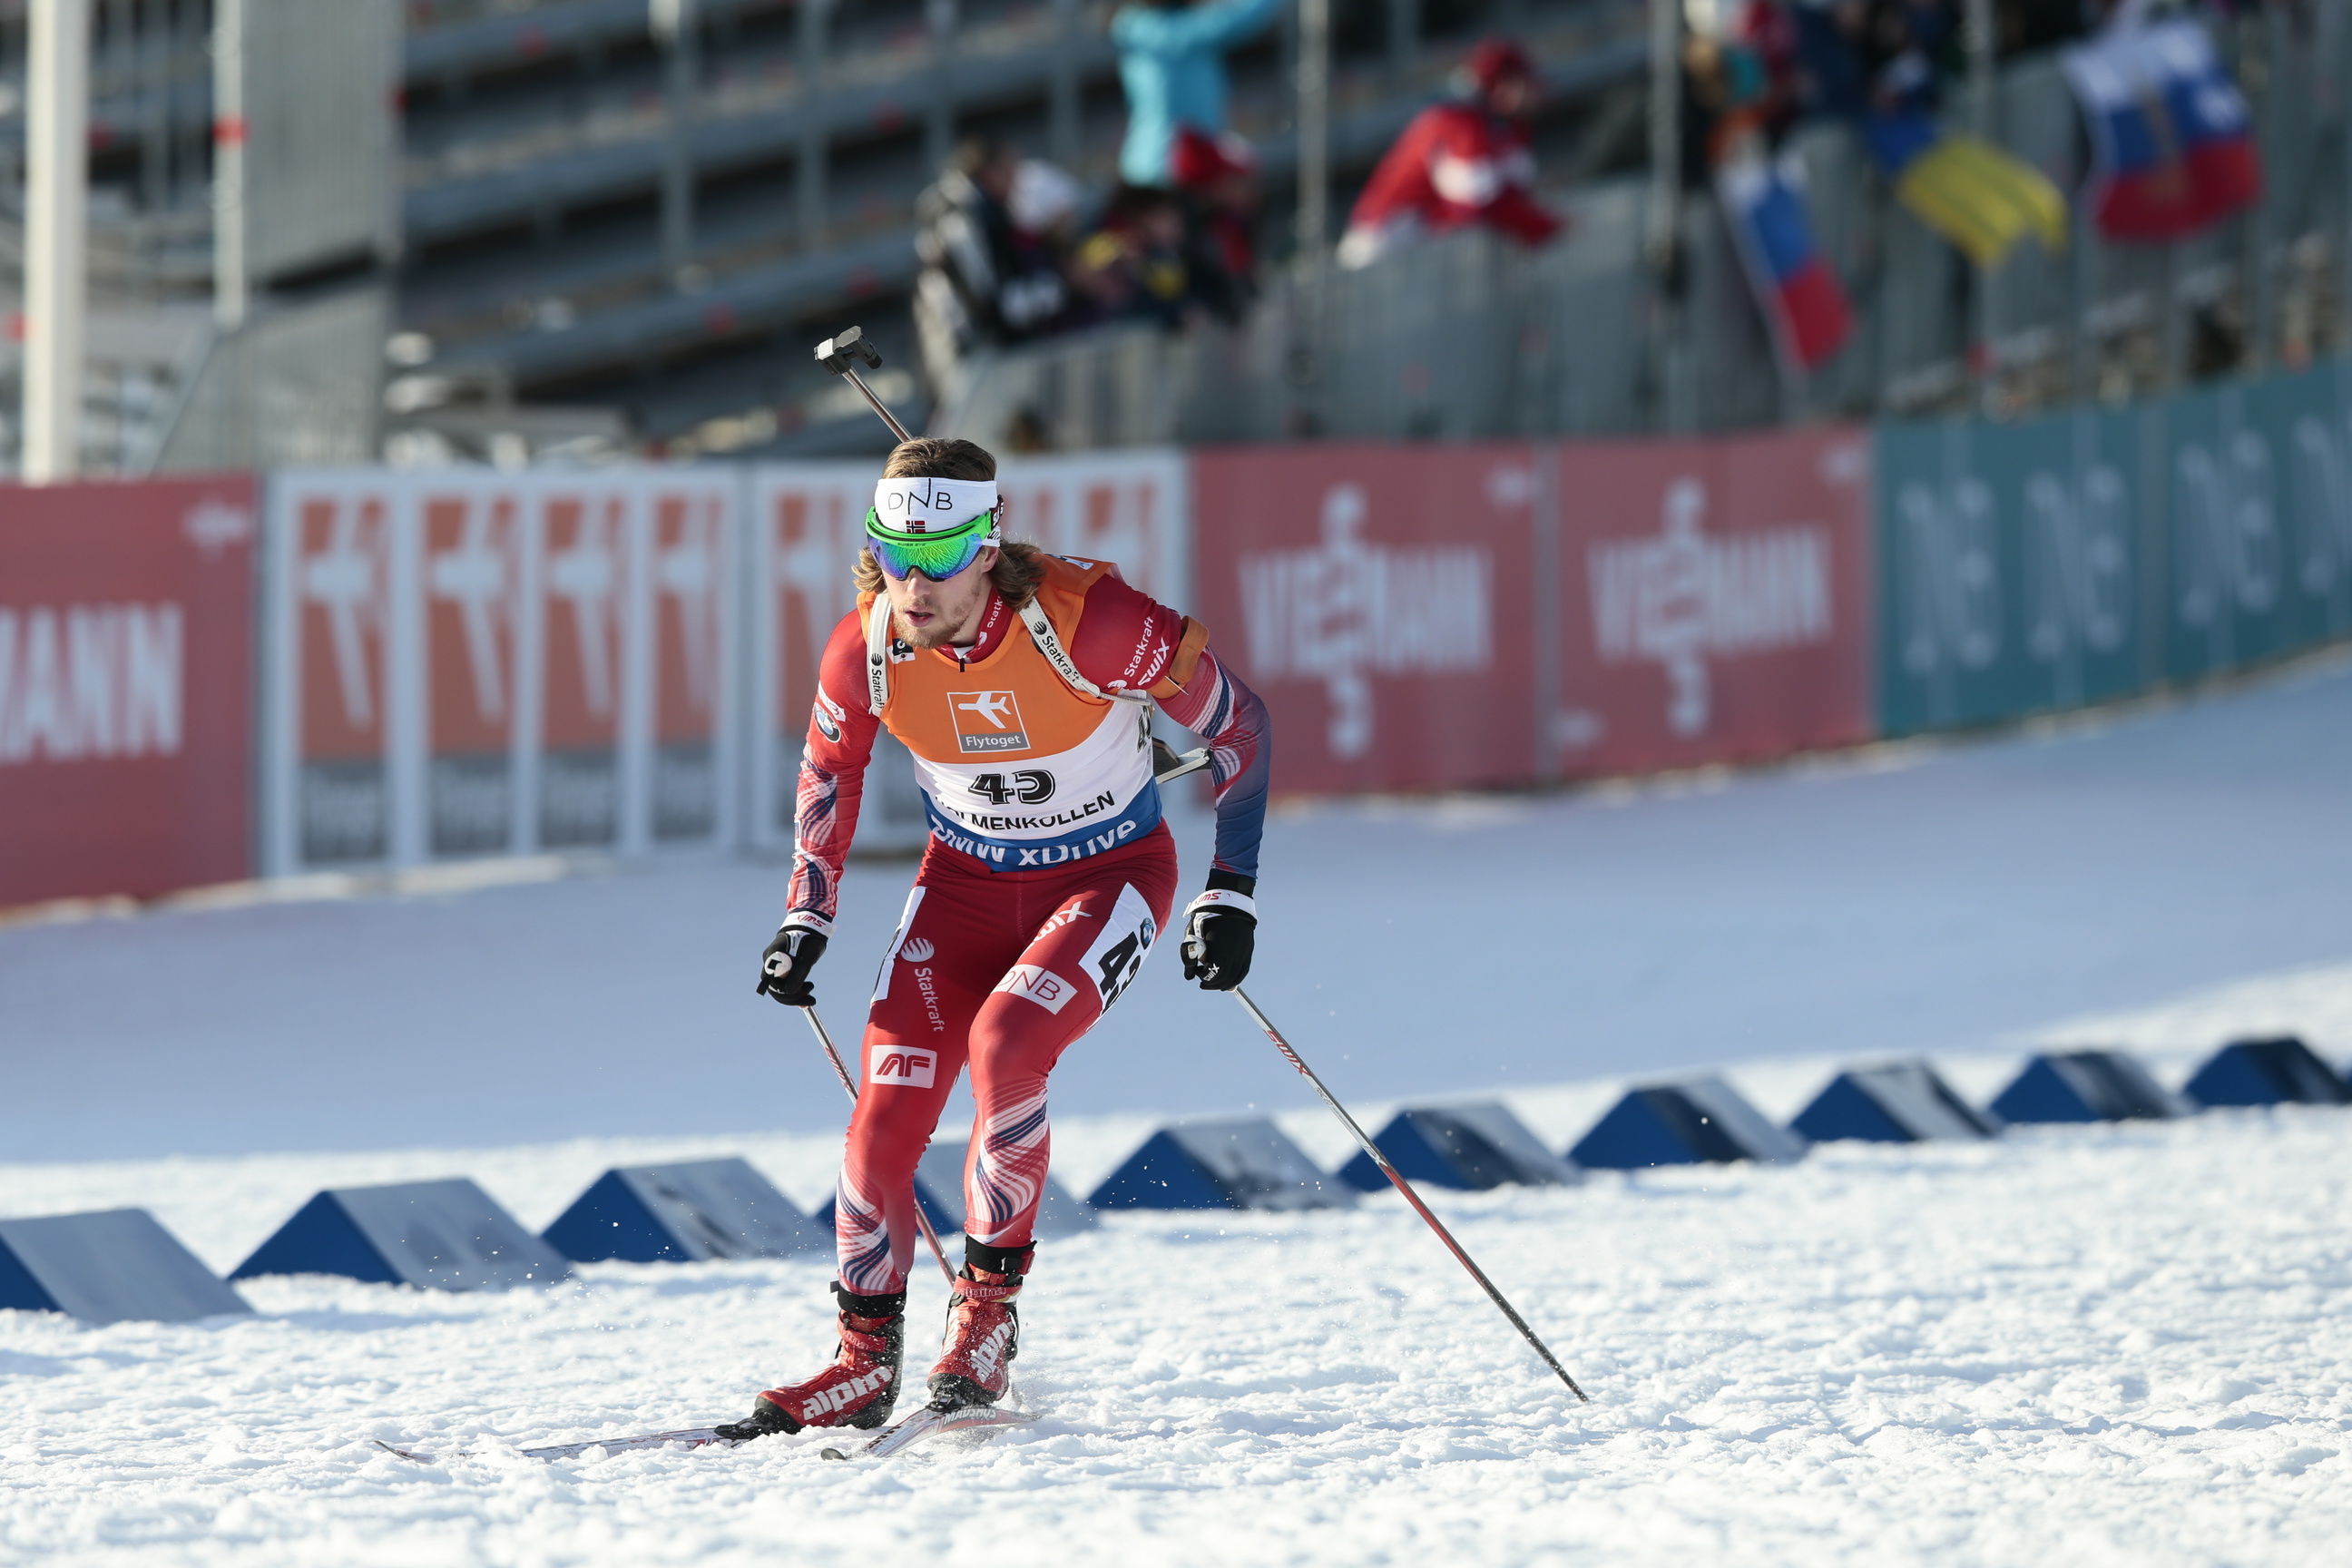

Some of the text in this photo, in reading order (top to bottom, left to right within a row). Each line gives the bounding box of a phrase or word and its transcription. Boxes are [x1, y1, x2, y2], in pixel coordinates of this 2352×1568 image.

[887, 477, 953, 515] DNB
[1123, 615, 1154, 678] Statkraft
[965, 734, 1022, 749] Flytoget
[914, 966, 946, 1033] Statkraft
